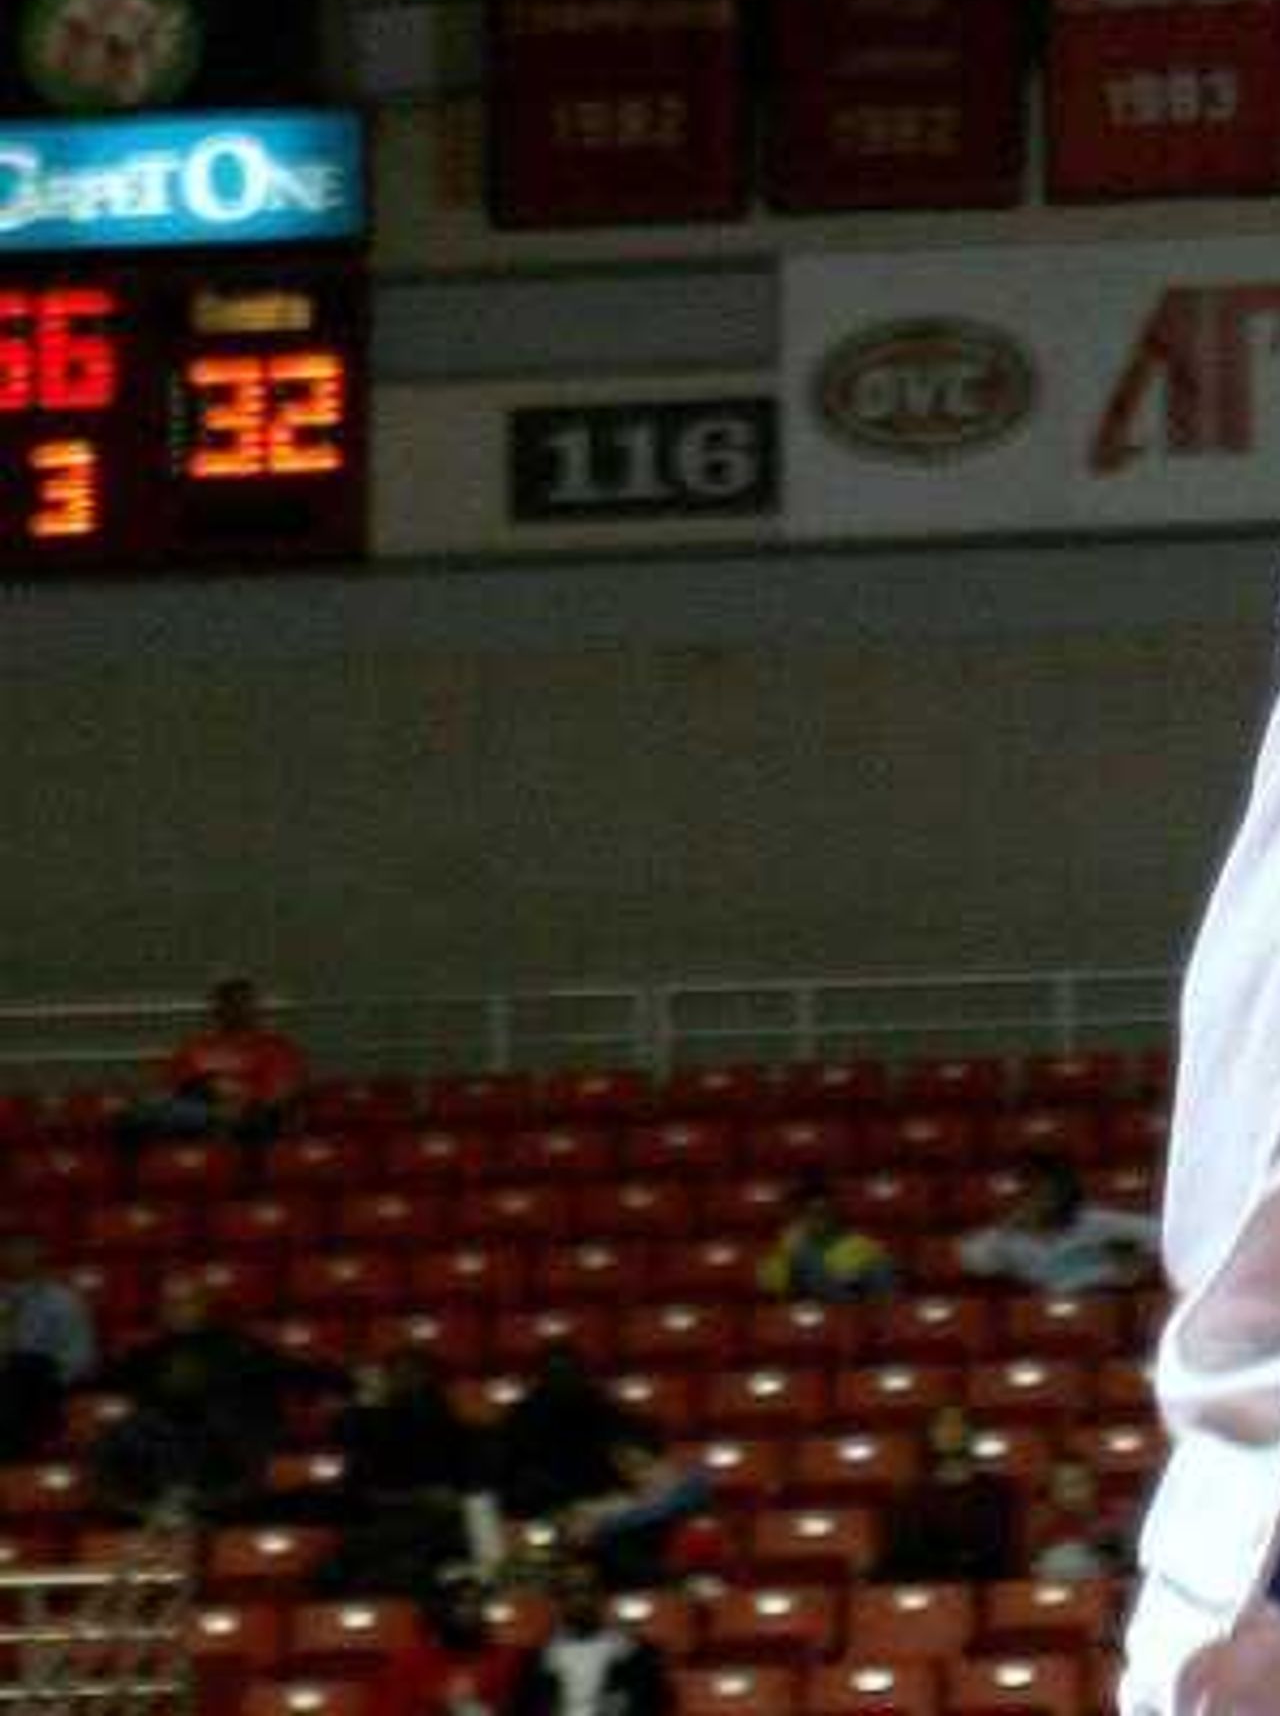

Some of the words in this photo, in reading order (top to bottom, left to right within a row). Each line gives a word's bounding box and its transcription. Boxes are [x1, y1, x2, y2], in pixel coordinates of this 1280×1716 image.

[188, 355, 345, 478] 32
[544, 421, 757, 505] 116
[30, 438, 95, 536] 3
